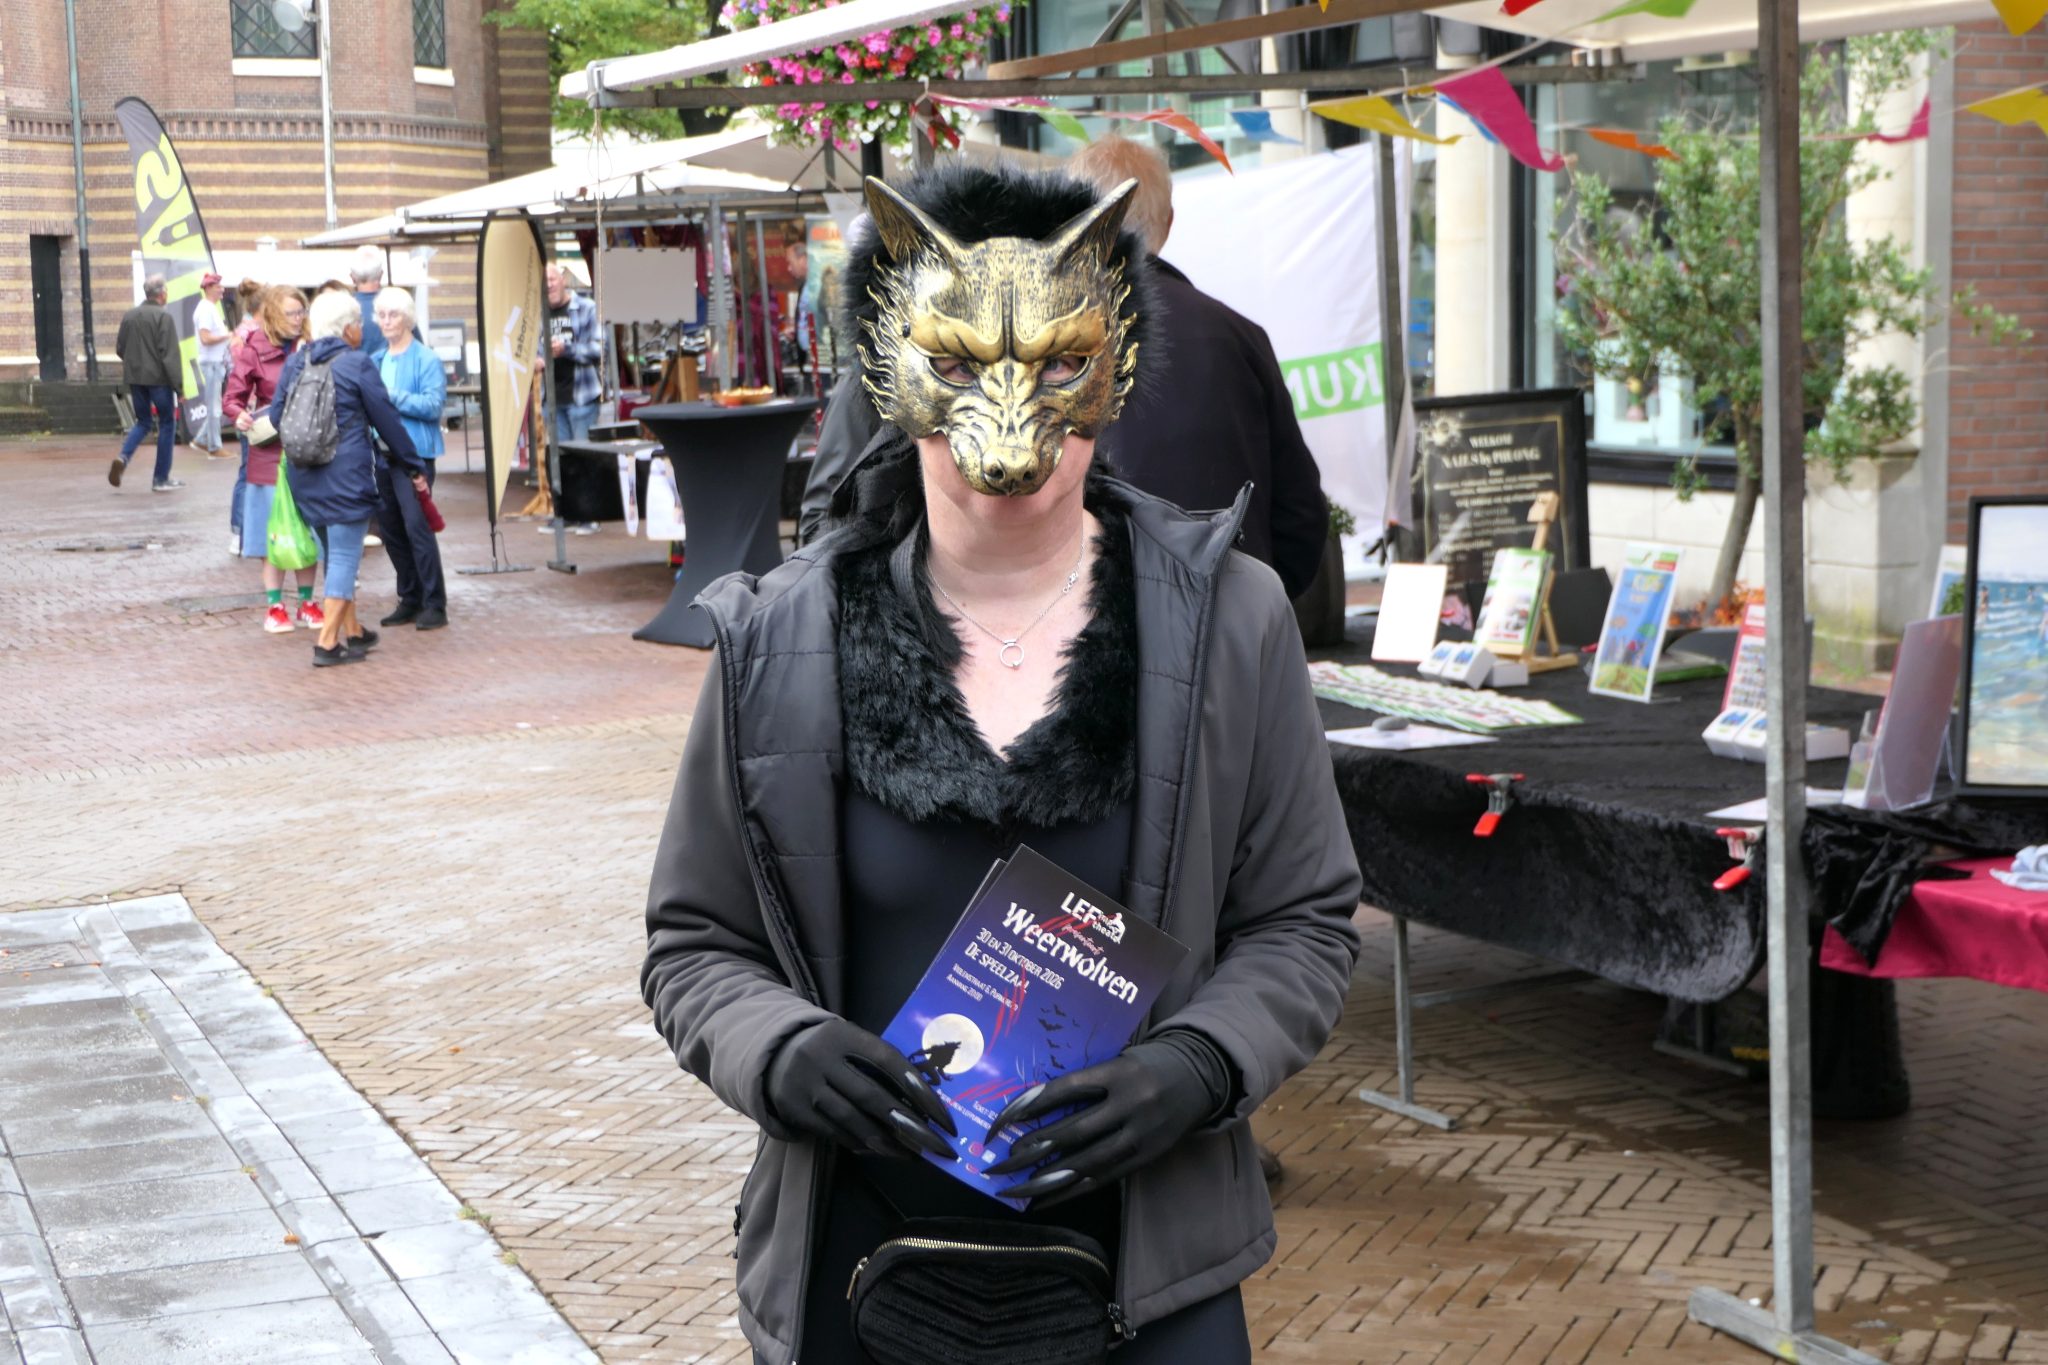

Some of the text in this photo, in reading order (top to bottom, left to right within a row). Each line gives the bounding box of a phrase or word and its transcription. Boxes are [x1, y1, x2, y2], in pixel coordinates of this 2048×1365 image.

[1060, 891, 1104, 924] LEF
[976, 927, 992, 944] 30
[998, 941, 1012, 958] 31
[1039, 967, 1065, 990] 2026
[1002, 901, 1139, 1005] Weerwolven
